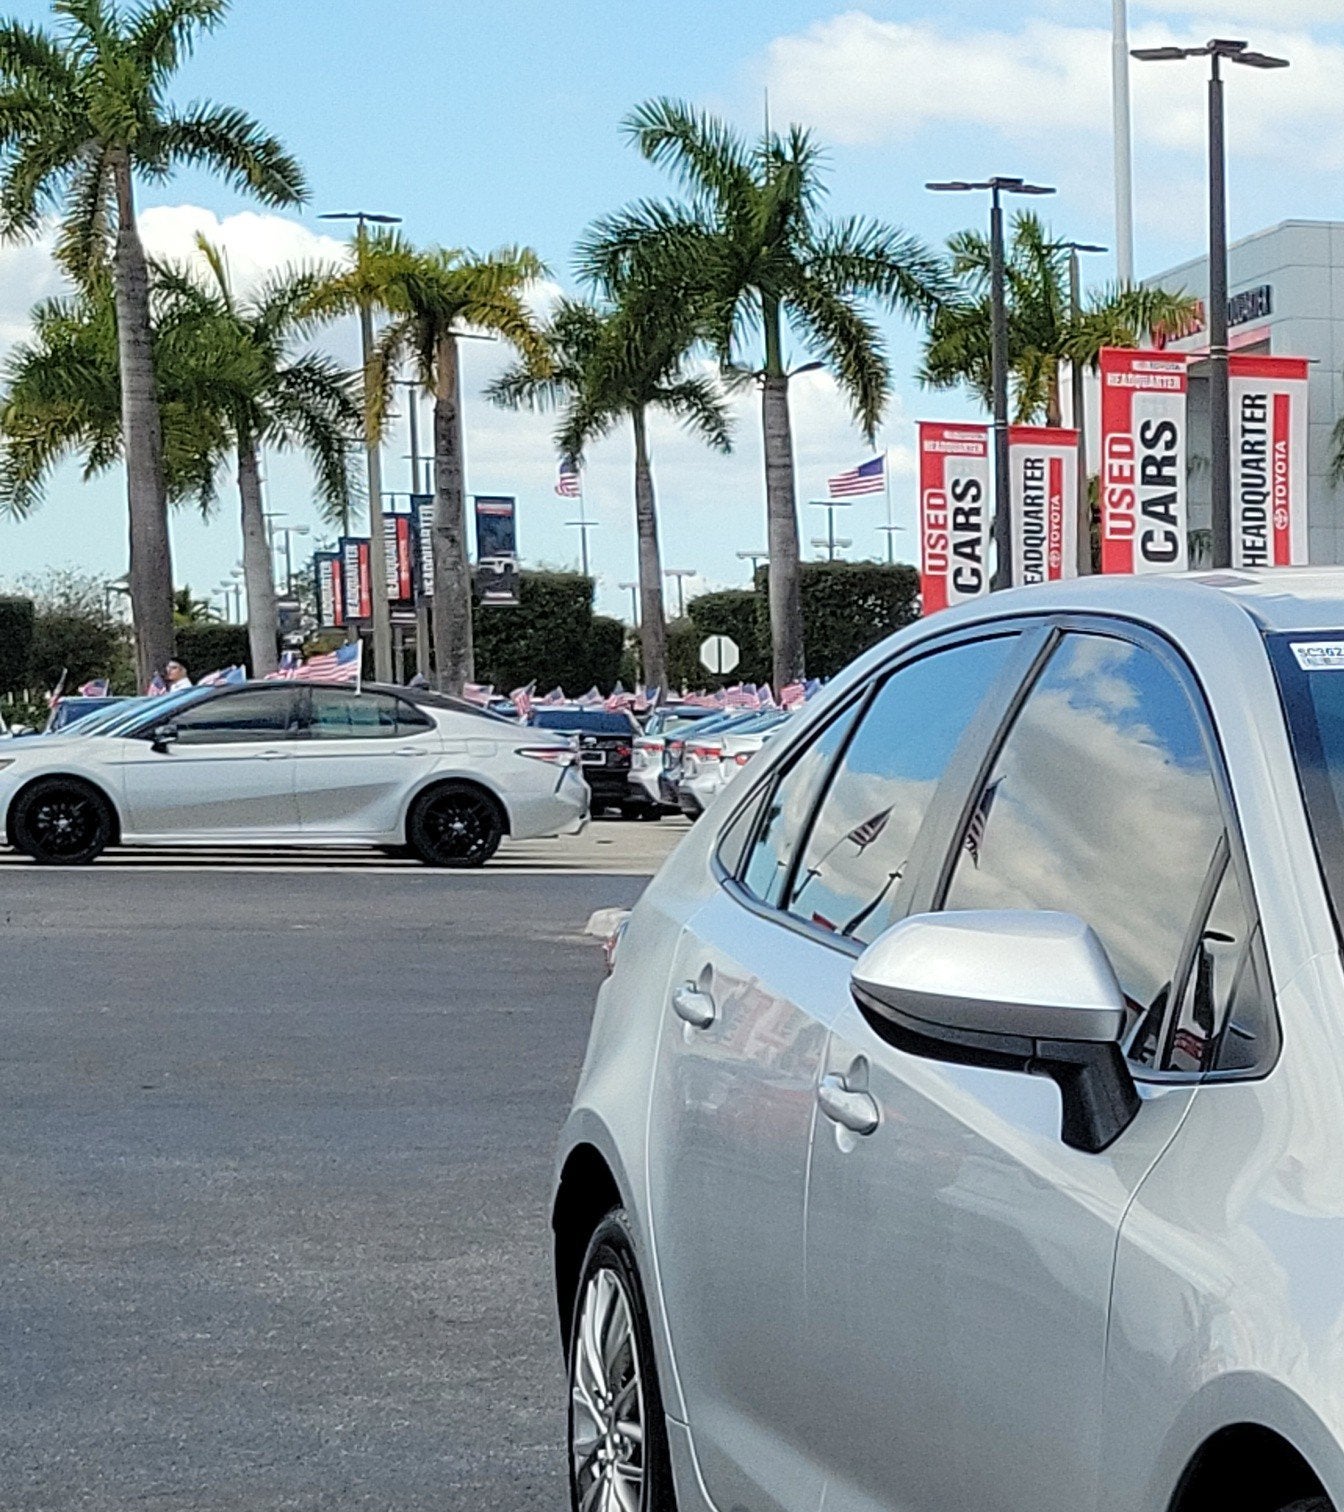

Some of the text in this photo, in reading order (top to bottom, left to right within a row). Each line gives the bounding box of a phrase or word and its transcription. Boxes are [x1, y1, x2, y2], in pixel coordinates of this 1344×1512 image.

[1023, 457, 1046, 584] EADQUARTER
[1105, 433, 1137, 541] USED
[1139, 419, 1179, 564] CARS
[1241, 393, 1270, 567] HEADQUARTER
[1273, 440, 1288, 503] TOYOTA
[925, 488, 949, 576] USED
[951, 478, 983, 594] CARS
